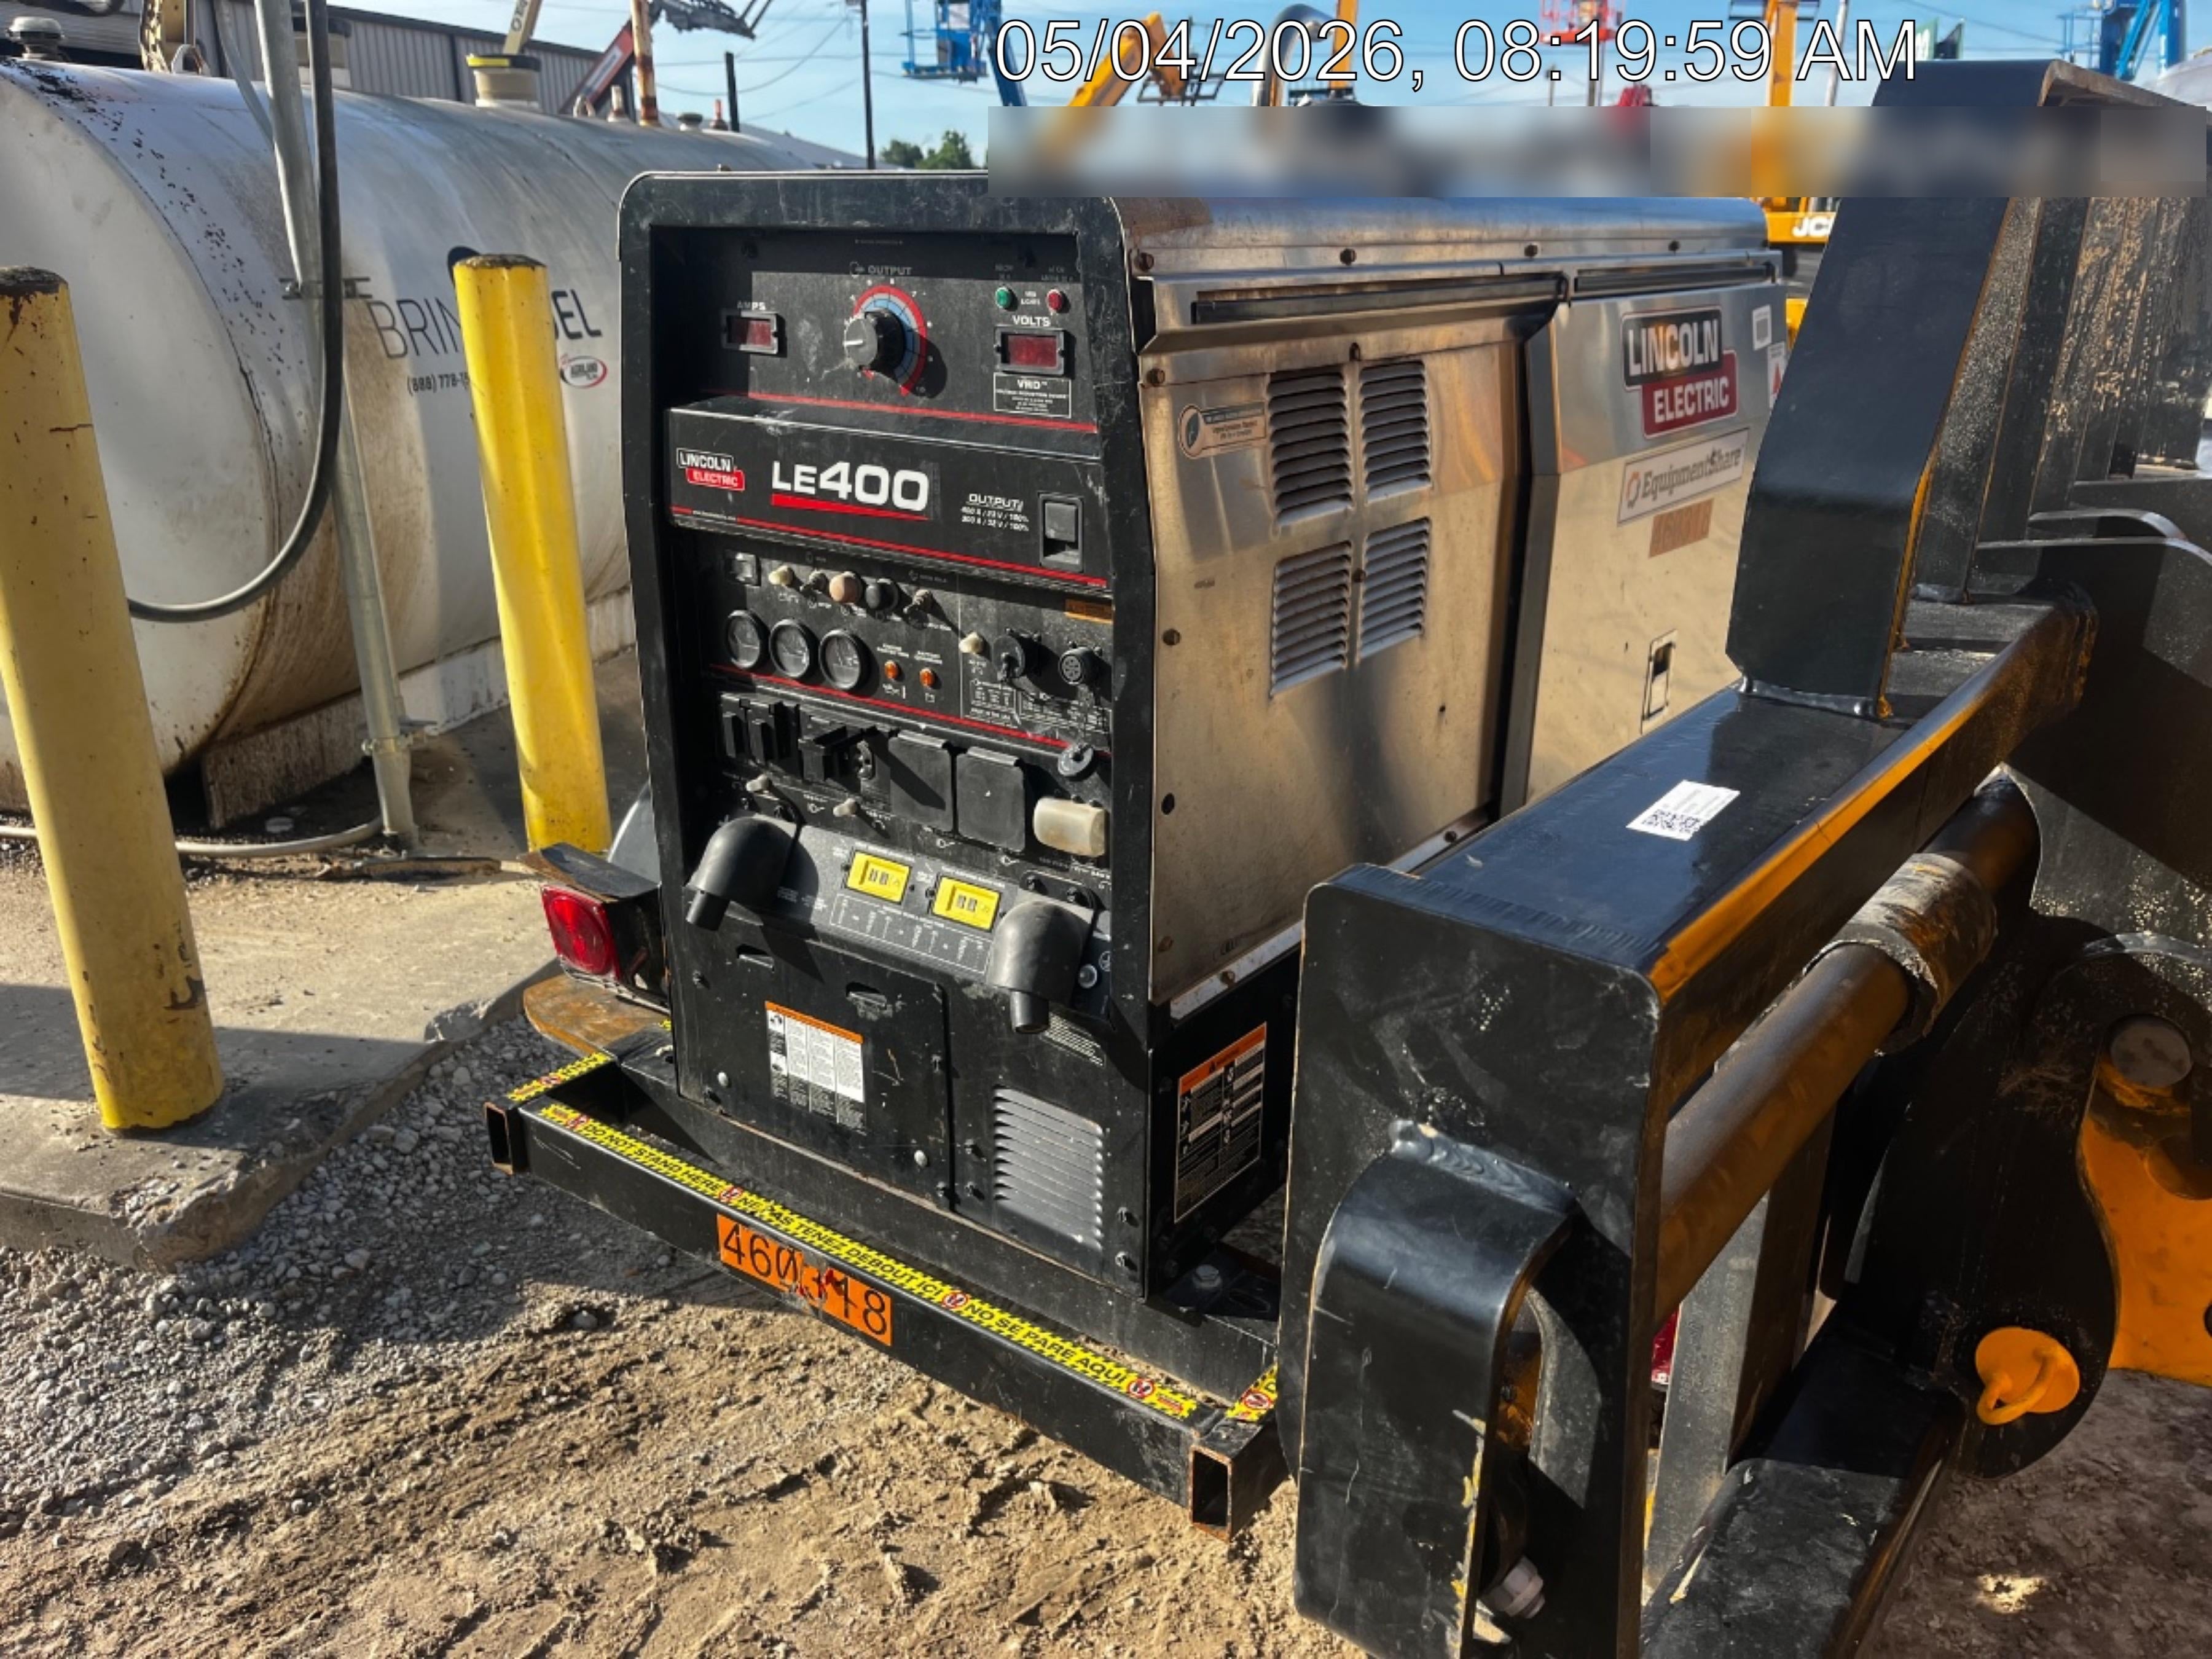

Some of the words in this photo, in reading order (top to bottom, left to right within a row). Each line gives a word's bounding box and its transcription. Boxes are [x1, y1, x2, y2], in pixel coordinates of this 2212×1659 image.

[867, 265, 912, 276] OUTPUT
[552, 289, 603, 340] EL
[737, 300, 766, 311] AMPS
[1011, 315, 1051, 327] VOLTS
[1628, 319, 1720, 377] LINCOLN
[1653, 375, 1731, 425] ELECTRIC
[680, 450, 731, 473] LINCOLN
[692, 470, 739, 487] ELECTRIC
[771, 460, 929, 511] LE400
[1642, 446, 1741, 501] EquipmentShare
[585, 1123, 606, 1136] DO
[633, 1147, 682, 1173] STAND
[683, 1169, 724, 1191] HERE
[847, 1247, 917, 1283] DEBOUT
[917, 1281, 944, 1296] ICI
[964, 1304, 995, 1320] NO
[995, 1317, 1023, 1335] SE
[1024, 1331, 1075, 1359] PARE
